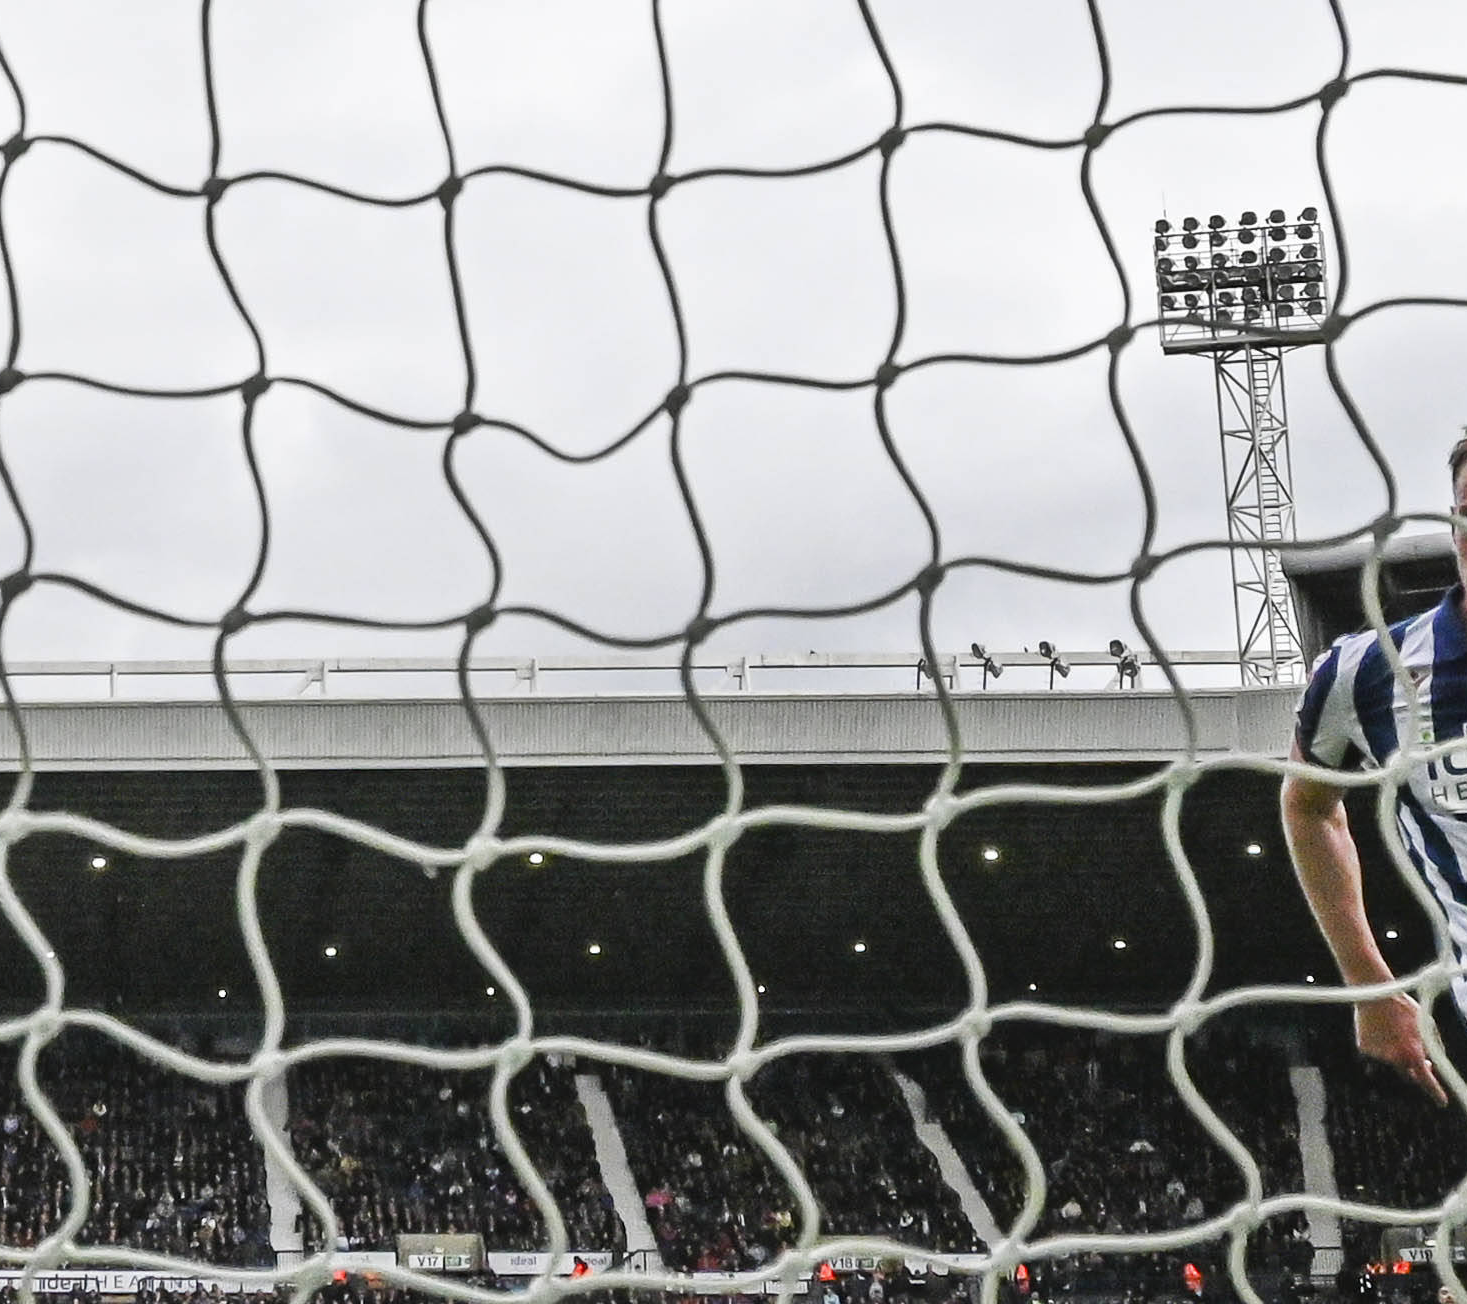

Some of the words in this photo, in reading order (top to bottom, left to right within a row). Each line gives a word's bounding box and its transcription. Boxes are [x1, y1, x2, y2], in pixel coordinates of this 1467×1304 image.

[417, 1256, 438, 1267] V17
[510, 1255, 538, 1266] ideal
[39, 1274, 88, 1291] idel
[96, 1274, 200, 1291] HEANG
